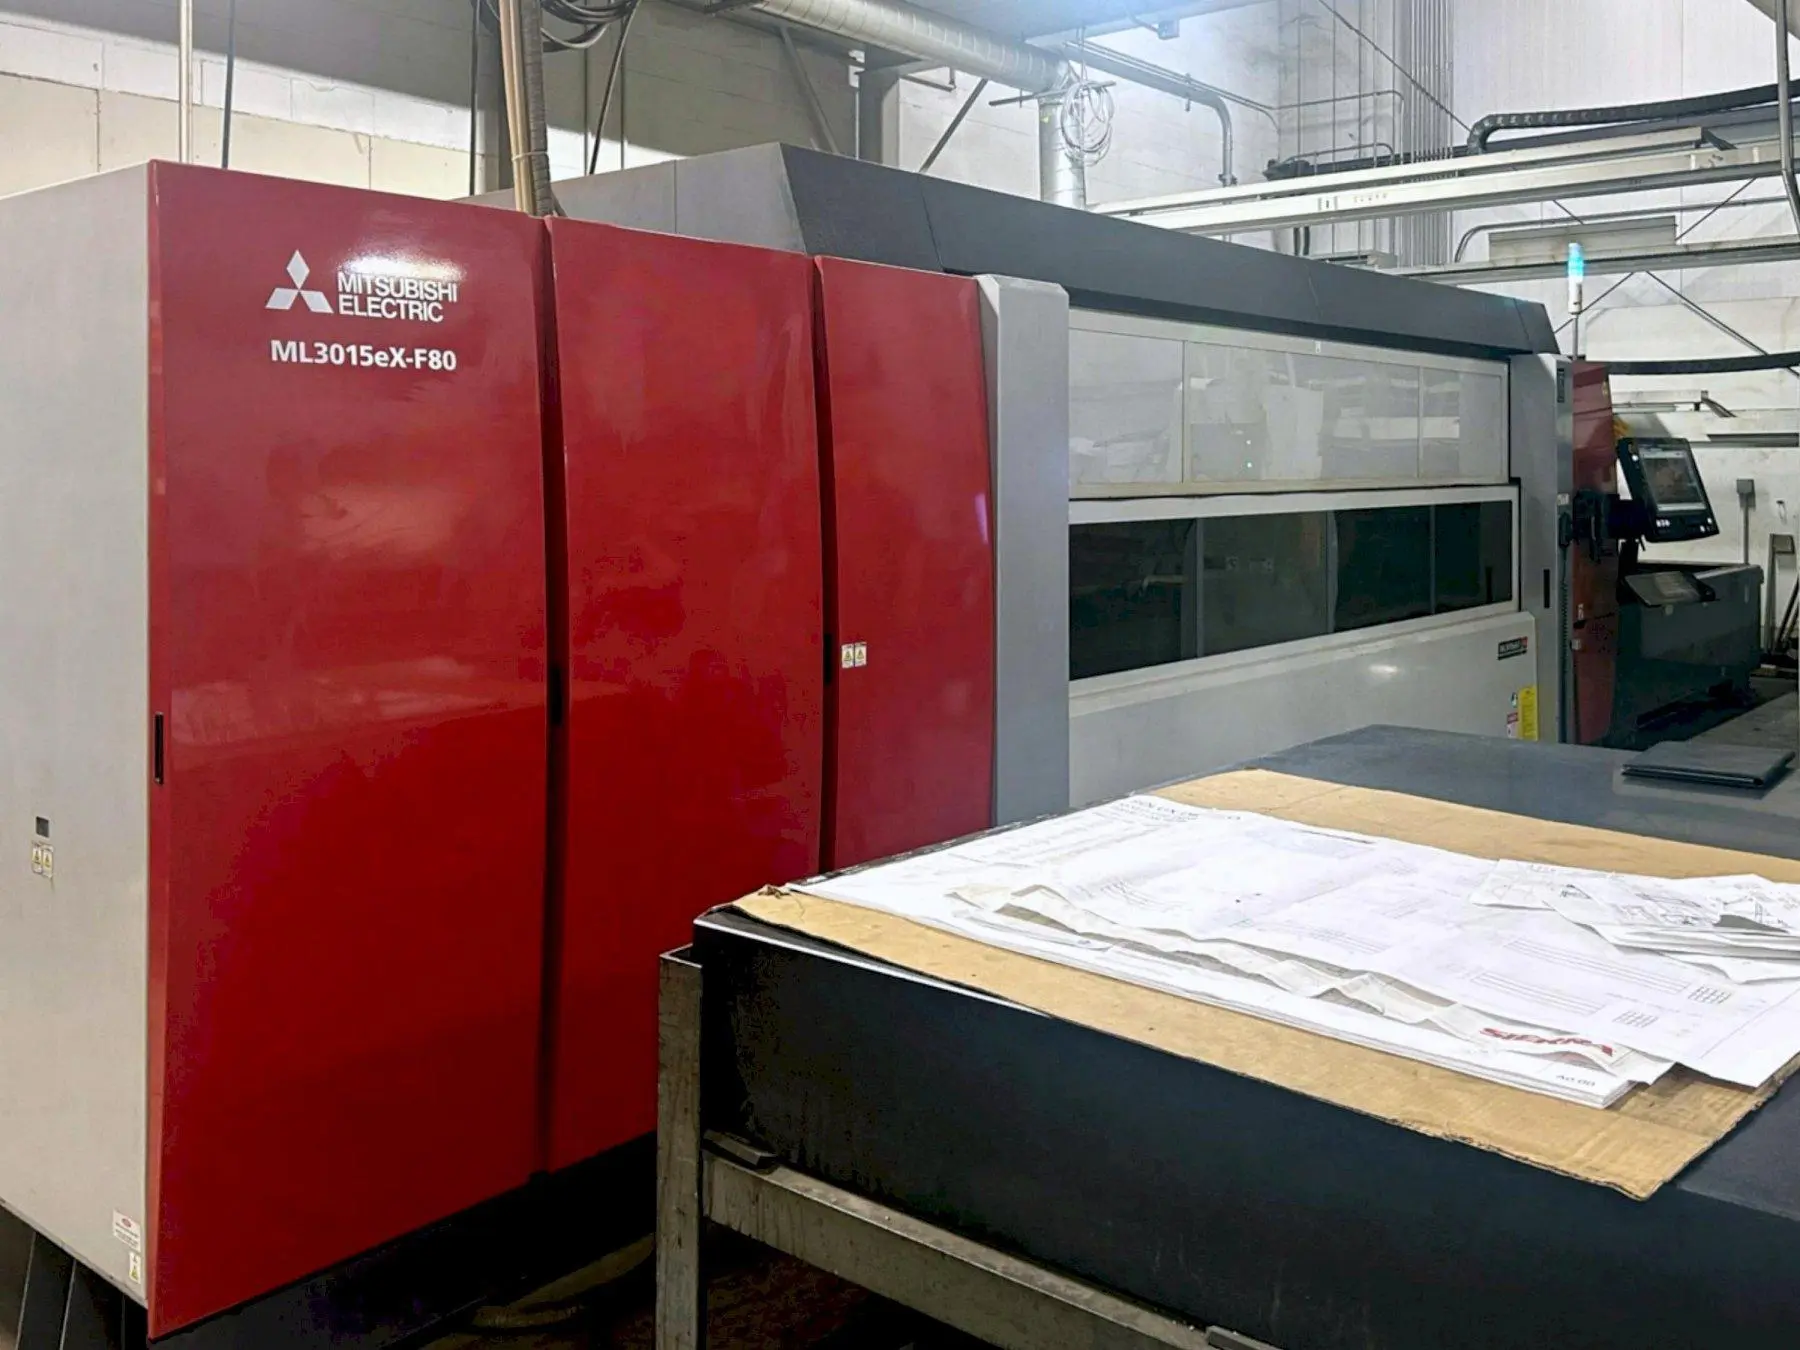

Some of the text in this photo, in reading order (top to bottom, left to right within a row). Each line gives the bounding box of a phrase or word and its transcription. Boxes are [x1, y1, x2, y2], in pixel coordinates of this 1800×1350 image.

[337, 271, 458, 303] MITSUBISHI
[338, 295, 444, 323] ELECTRIC
[270, 340, 457, 371] ML3015eX-F80
